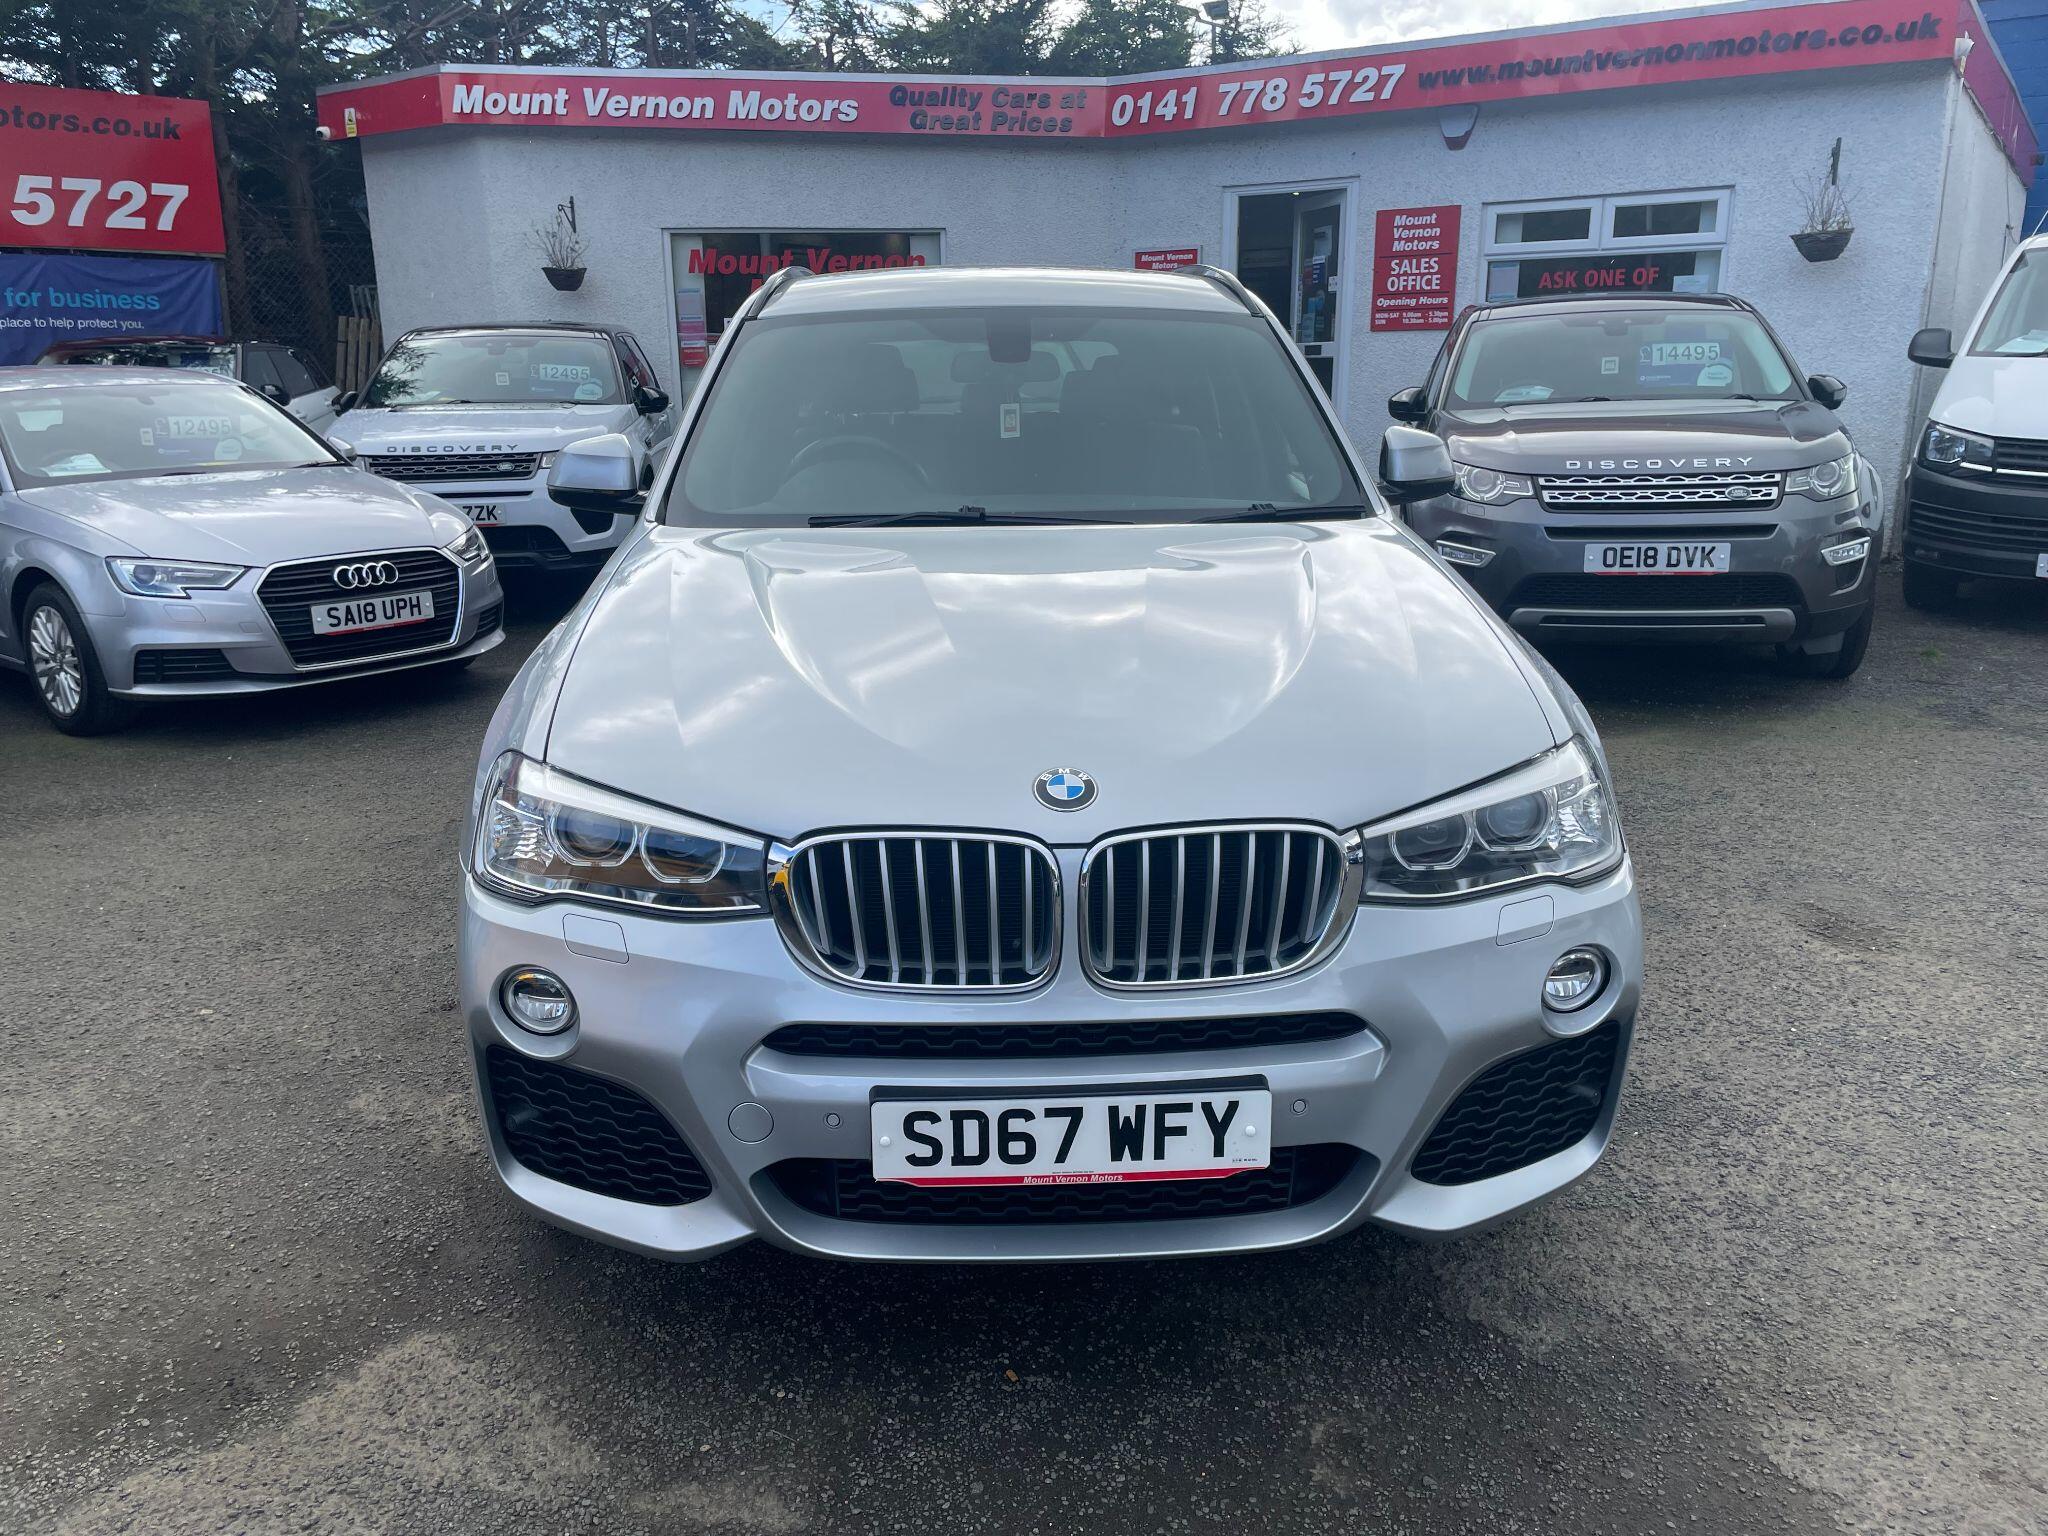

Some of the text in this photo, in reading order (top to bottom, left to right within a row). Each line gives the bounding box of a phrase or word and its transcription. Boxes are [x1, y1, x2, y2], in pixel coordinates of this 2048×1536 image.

[1418, 13, 1943, 90] www.mountvernonmotors.co.uk
[452, 84, 859, 122] Mount Vernon Motors
[889, 85, 1088, 111] Quality Cars at
[1111, 63, 1406, 126] 0141 778 5727
[909, 109, 1073, 133] Great Prices
[10, 174, 189, 231] 5727
[1393, 213, 1437, 226] Mount
[1393, 227, 1440, 239] Vernon
[1392, 240, 1440, 252] Motors
[688, 248, 926, 275] Mount Vernon
[1141, 253, 1193, 262] Mount Vernon
[1151, 262, 1178, 270] Motors
[1390, 258, 1439, 275] SALES
[1387, 274, 1441, 291] OFFICE
[1538, 267, 1660, 289] ASK ONE OF
[4, 287, 161, 310] for business
[1376, 296, 1449, 308] Opening Hours
[0, 317, 145, 332] place to help protect you.
[387, 444, 518, 453] DISCOVERY
[1566, 457, 1753, 470] DISCOVERY
[1602, 546, 1716, 568] OE18 DVK
[326, 596, 423, 628] SA18 UPH
[1041, 768, 1090, 781] BMW
[902, 1101, 1240, 1167] SD67 WFY
[1023, 1174, 1123, 1184] Mount Vernon Motors
